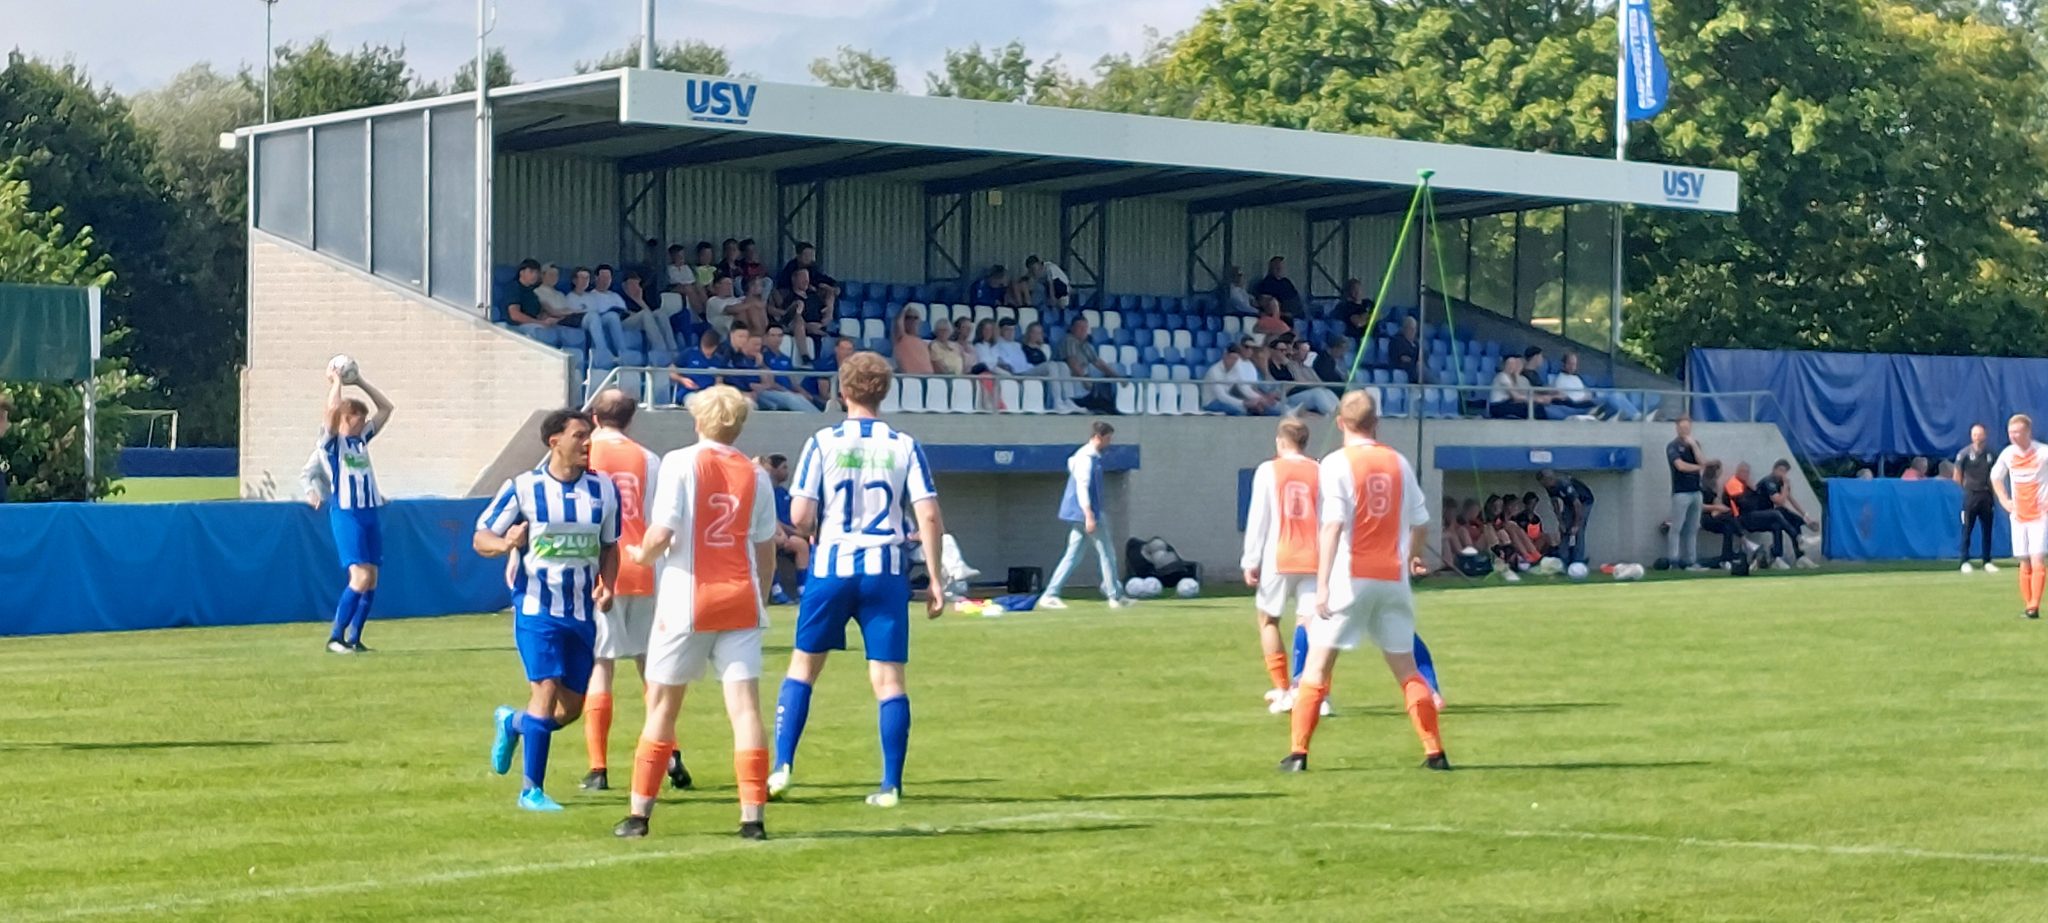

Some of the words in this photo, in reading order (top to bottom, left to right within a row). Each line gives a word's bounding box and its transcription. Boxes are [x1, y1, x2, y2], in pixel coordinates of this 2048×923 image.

[686, 79, 757, 117] USV
[1663, 170, 1705, 198] USV
[834, 478, 896, 536] 12
[1283, 480, 1310, 520] 6
[1366, 472, 1393, 518] 8
[704, 492, 740, 547] 2
